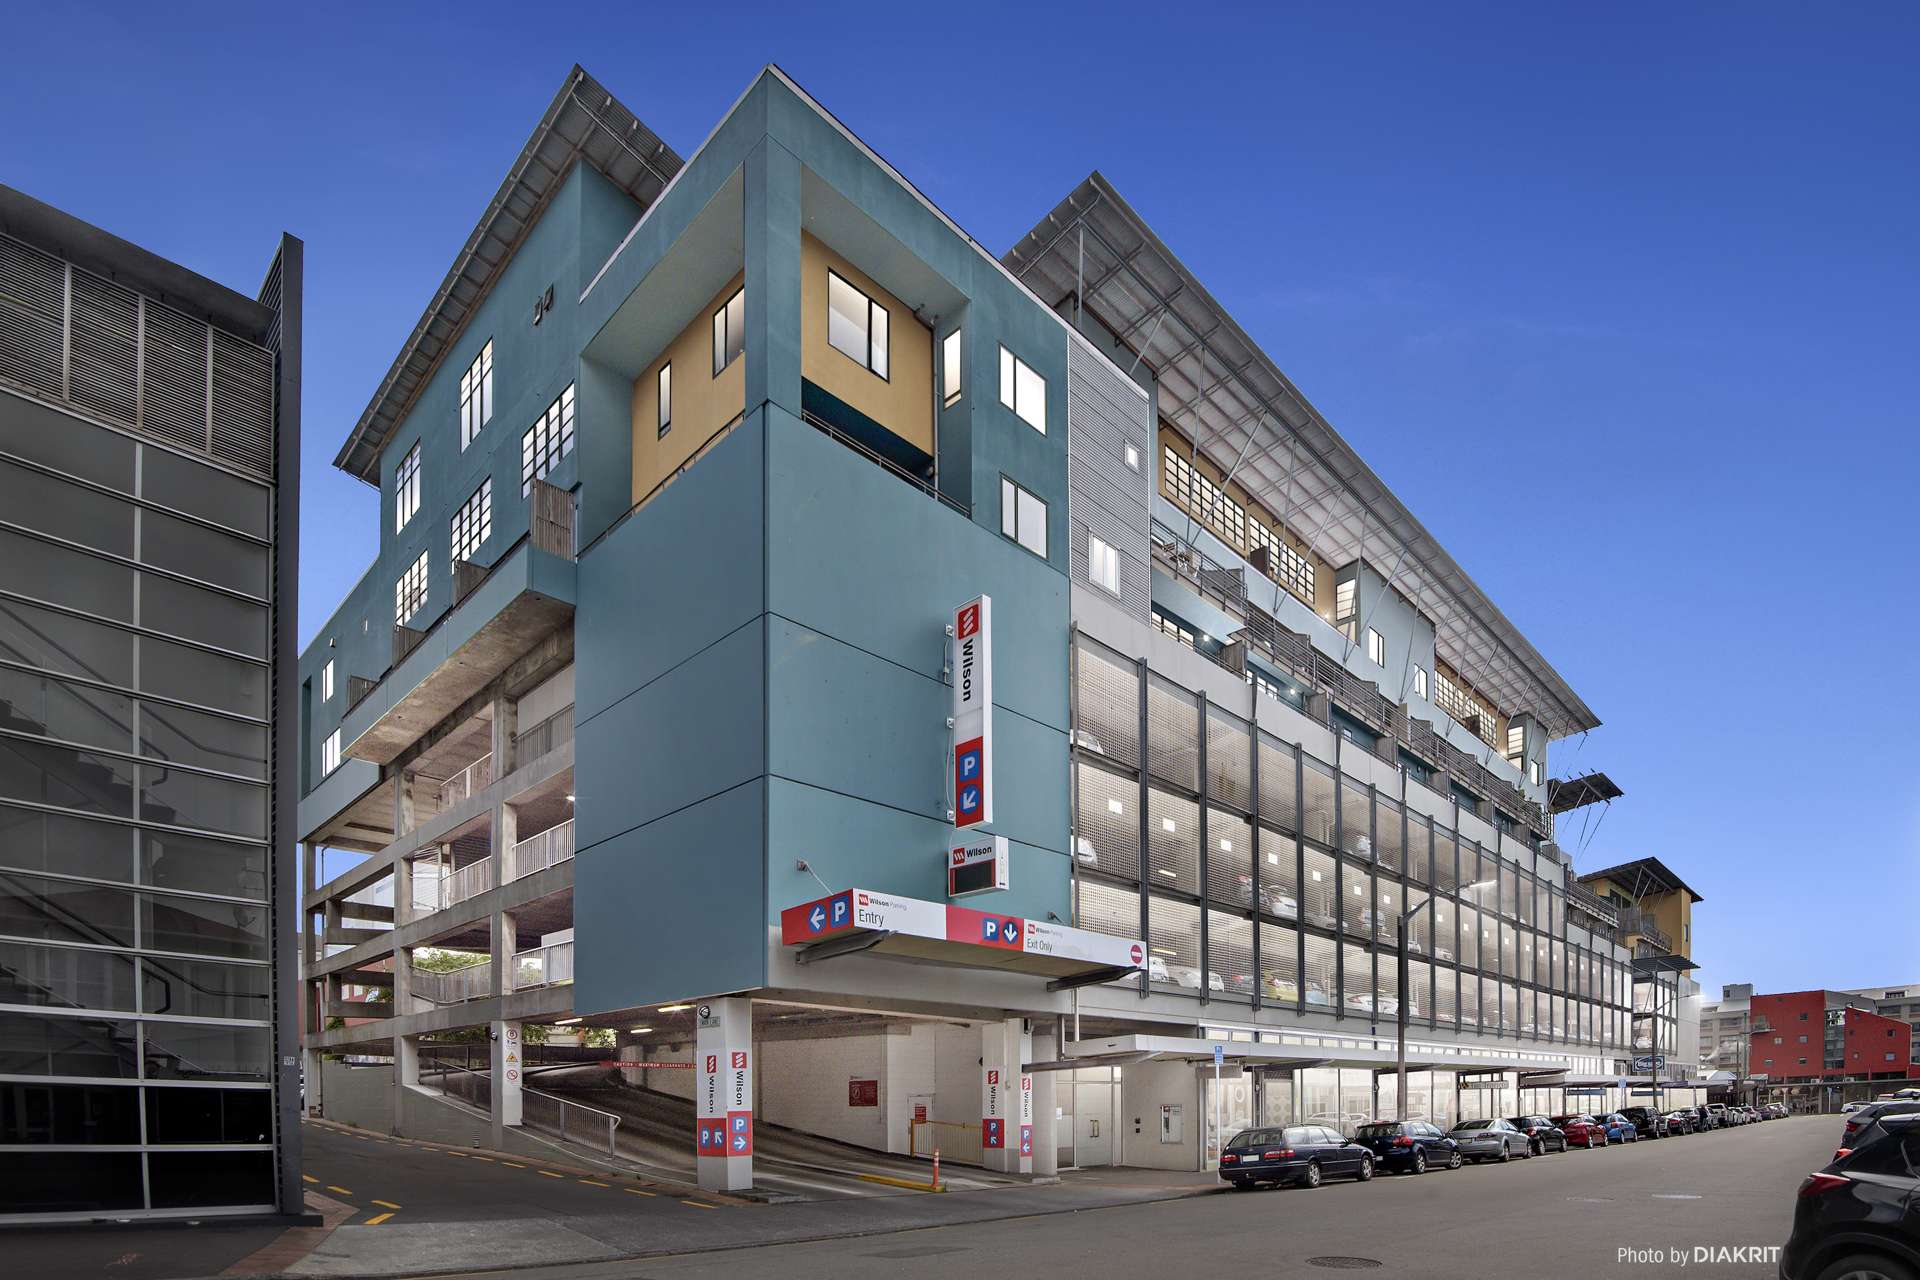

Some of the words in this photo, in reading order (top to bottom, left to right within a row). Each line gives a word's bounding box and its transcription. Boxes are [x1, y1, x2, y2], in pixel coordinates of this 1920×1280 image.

[963, 638, 974, 702] Wilson
[964, 756, 976, 776] P
[966, 846, 992, 858] Wilson
[869, 897, 890, 907] Wilson
[835, 901, 846, 922] P
[859, 909, 884, 927] Entry
[986, 921, 997, 937] P
[1027, 938, 1038, 950] Exit
[1040, 940, 1053, 952] Only
[736, 1070, 744, 1106] Wilson
[736, 1119, 744, 1130] P
[703, 1130, 709, 1144] P
